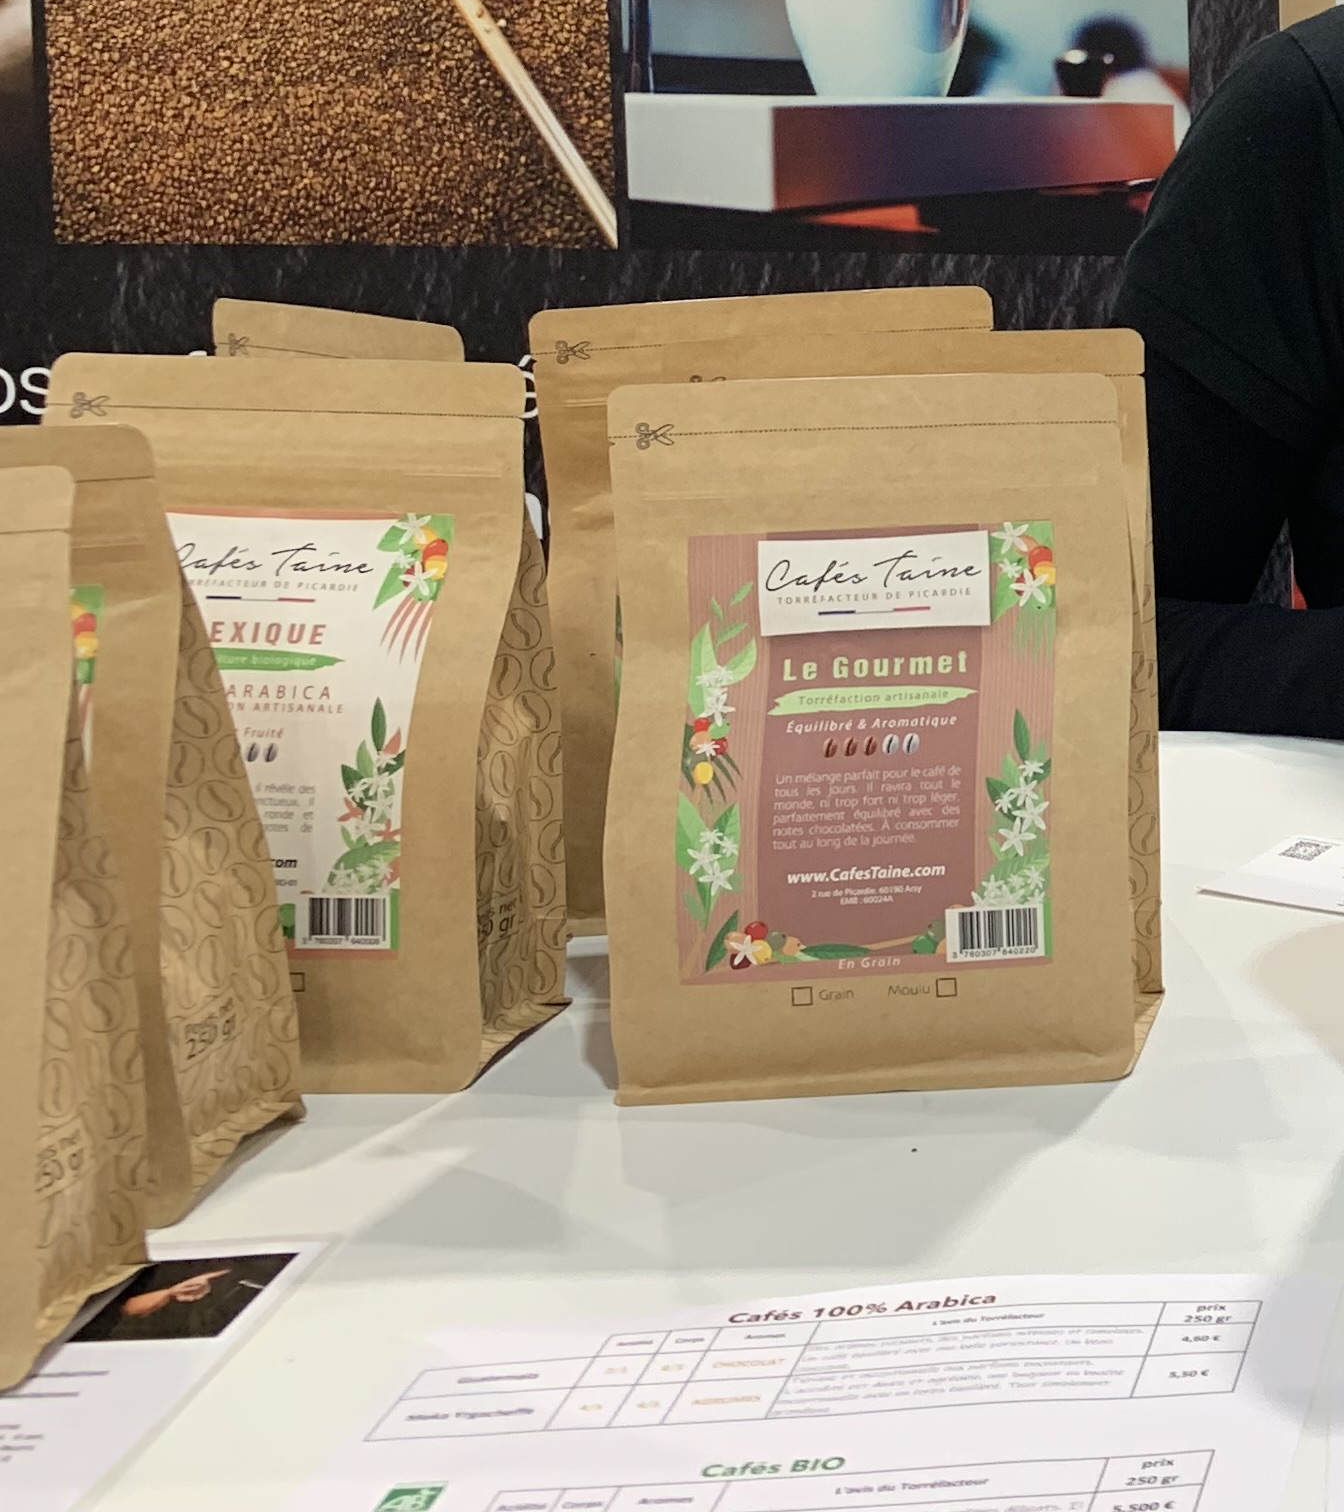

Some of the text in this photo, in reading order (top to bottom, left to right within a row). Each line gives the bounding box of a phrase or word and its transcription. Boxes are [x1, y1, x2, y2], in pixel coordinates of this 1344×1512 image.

[272, 543, 373, 576] Taine
[765, 549, 983, 593] Cafés Taine
[274, 580, 359, 592] DE PICARDIE
[776, 587, 971, 606] TORRÉFACTEUR DE PICARDIE
[210, 621, 327, 646] EXIQUE
[783, 649, 968, 681] Le Gourmet
[226, 684, 331, 701] ARABICA
[798, 688, 949, 707] Torréfaction artisanale
[252, 702, 344, 715] ARTISANALE
[786, 714, 957, 735] Équilibré & Aromatique
[776, 764, 962, 786] Un mélange parfait pour le café de
[775, 787, 799, 798] tous
[806, 786, 821, 796] les
[951, 779, 961, 789] le
[820, 793, 927, 810] ni trop fort ni trop
[773, 810, 845, 826] parfaitement
[908, 806, 933, 817] avec
[941, 804, 961, 816] des
[773, 818, 960, 837] notes consommer
[773, 834, 870, 851] tout au long de la
[787, 865, 946, 884] www.CafesTaine.com
[838, 956, 901, 970] En Grain
[819, 984, 931, 1001] Grain Moulu
[728, 1293, 997, 1325] Cafés 100% Arabica
[1196, 1303, 1226, 1314] prix
[1184, 1315, 1232, 1326] 250 gr
[701, 1456, 846, 1478] Cafés BIO
[1141, 1458, 1174, 1471] prix
